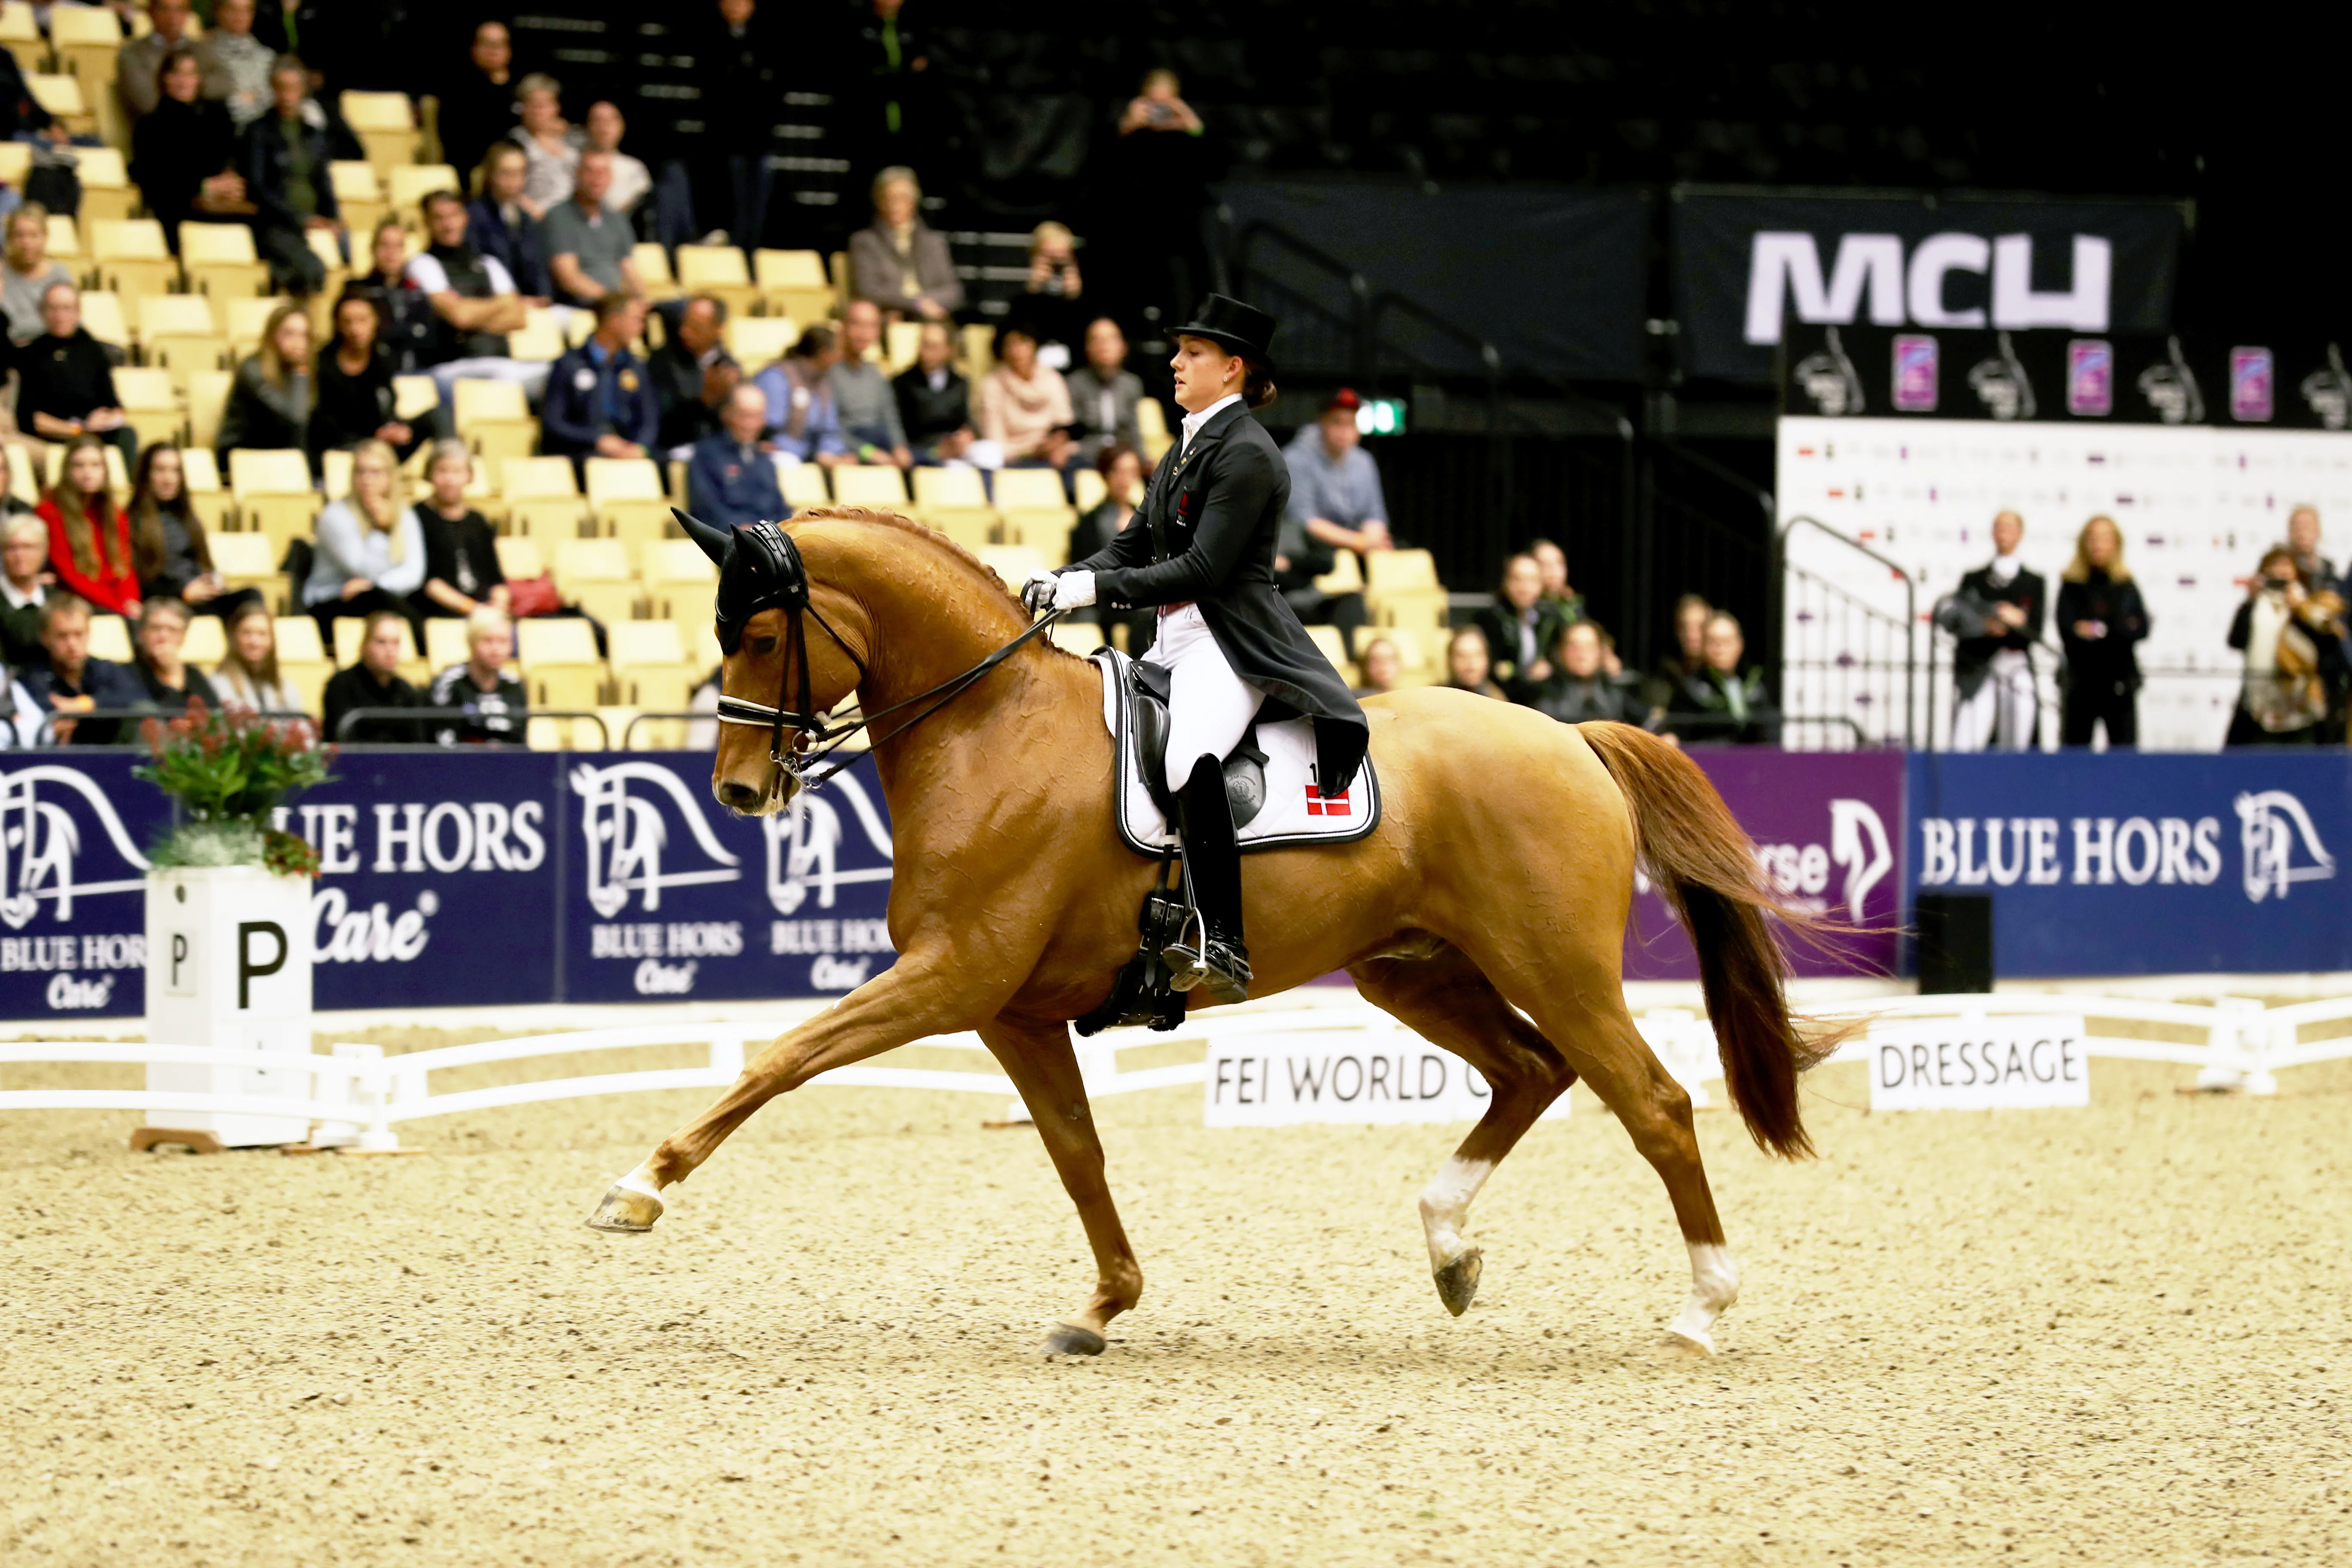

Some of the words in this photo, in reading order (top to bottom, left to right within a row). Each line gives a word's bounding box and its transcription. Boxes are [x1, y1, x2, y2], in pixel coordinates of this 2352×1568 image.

[1743, 230, 2111, 345] MCH
[372, 801, 546, 873] HORS
[1920, 818, 2061, 885] BLUE
[2071, 816, 2221, 885] HORS
[1, 936, 78, 971] BLUE
[82, 934, 147, 969] HOR
[172, 934, 188, 986] P
[237, 921, 288, 1009] P
[1215, 1057, 1268, 1104] FEI
[1287, 1054, 1447, 1102] WORLD
[1880, 1038, 2079, 1088] DRESSAGE
